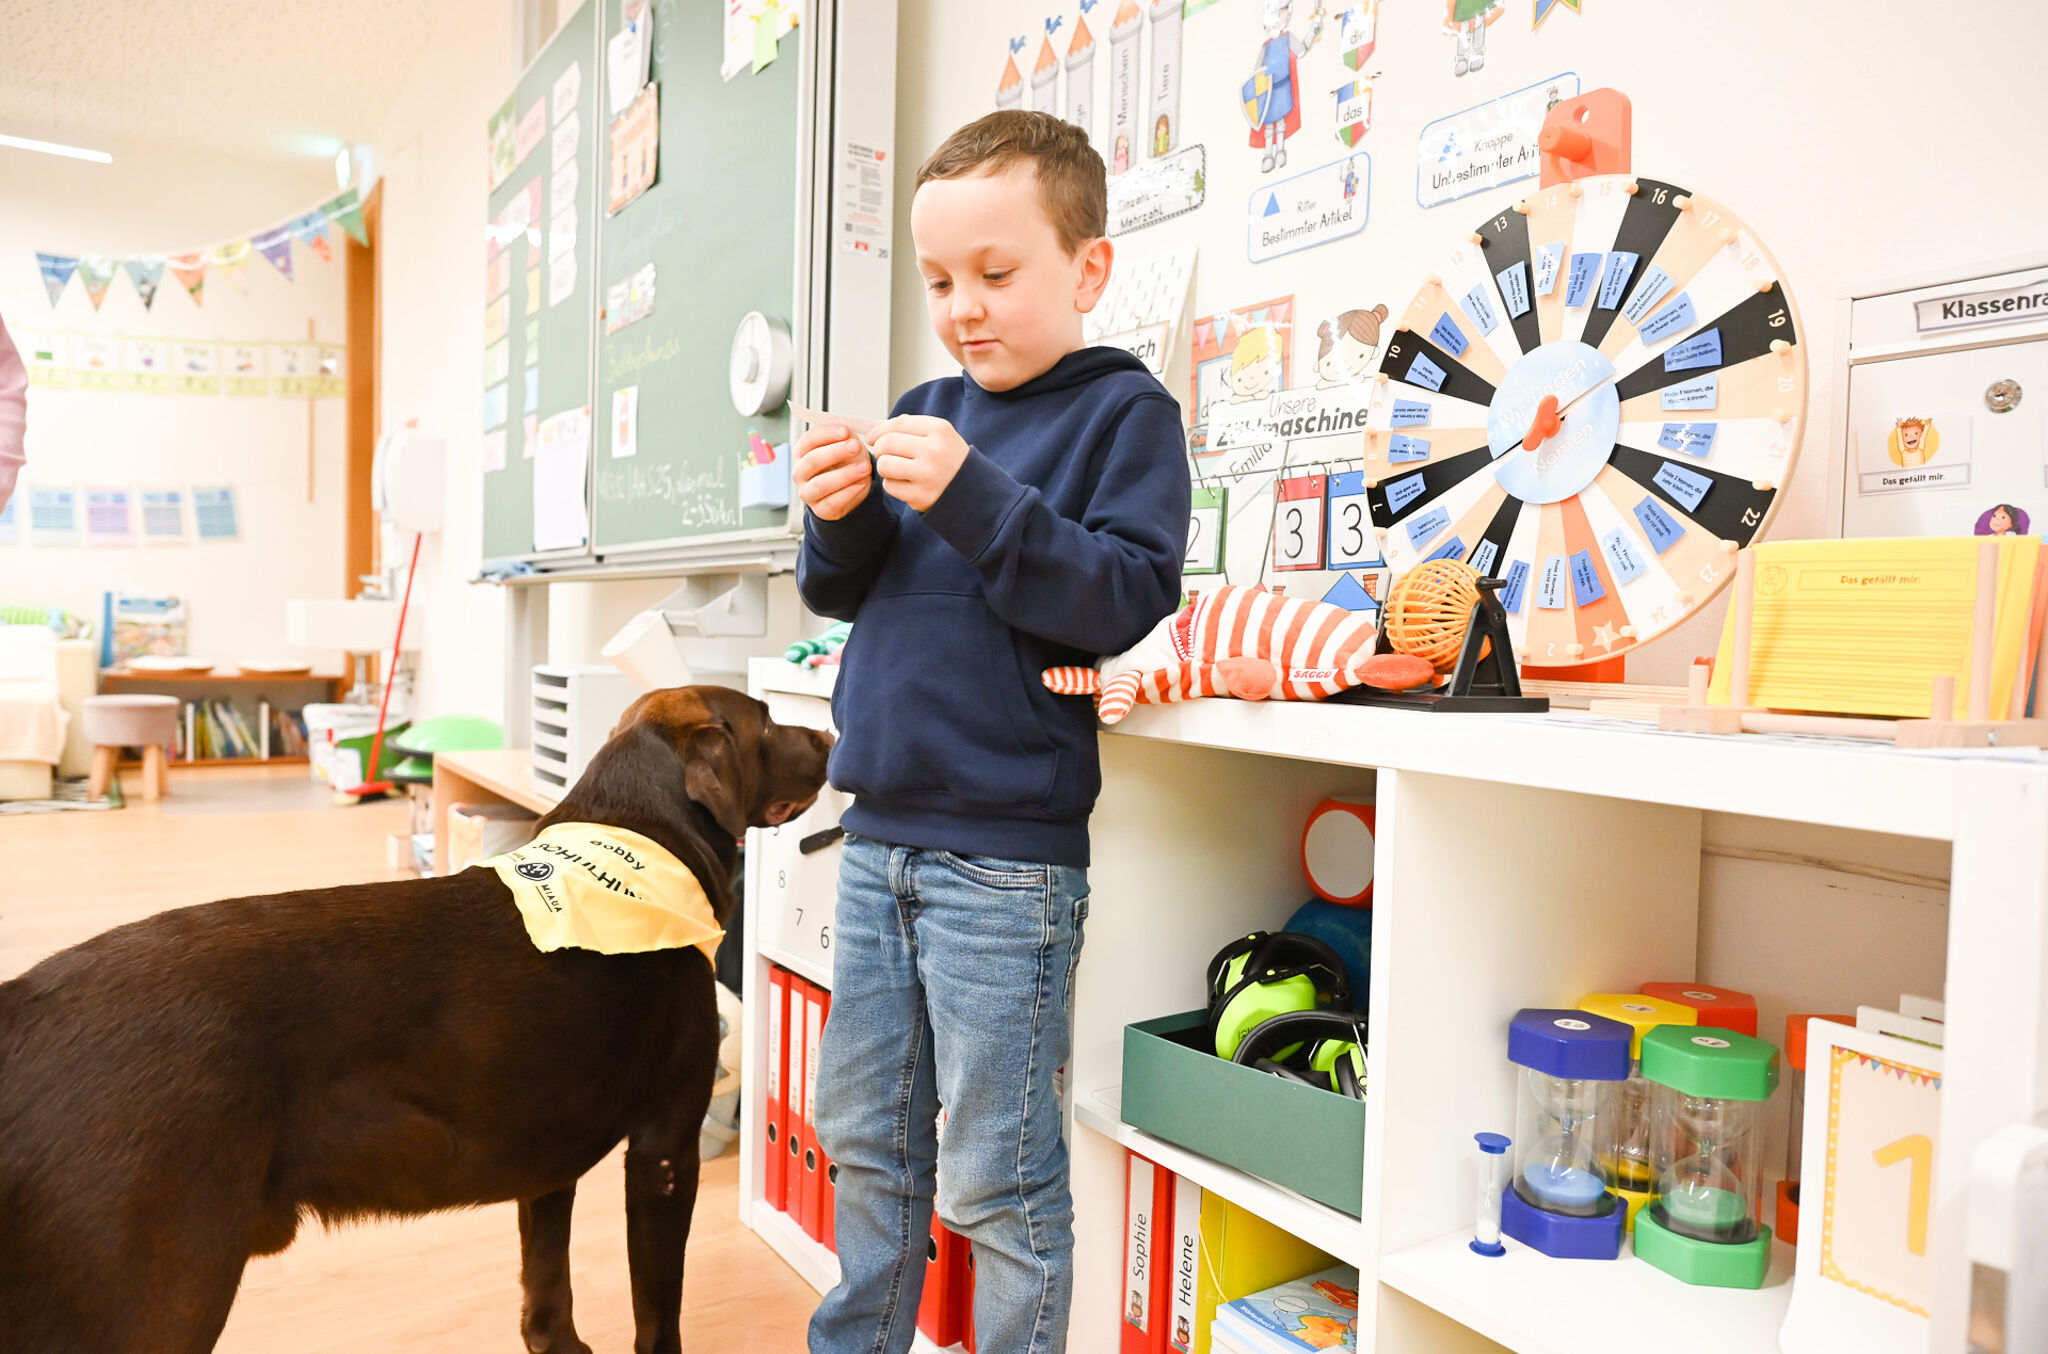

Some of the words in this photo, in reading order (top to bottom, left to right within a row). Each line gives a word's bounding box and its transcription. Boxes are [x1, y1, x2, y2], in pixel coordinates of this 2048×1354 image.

[1117, 48, 1129, 126] Menschen
[1158, 63, 1170, 104] Tiere
[1343, 105, 1363, 121] das
[1651, 187, 1668, 205] 16
[1262, 220, 1318, 247] Bestimmter
[1320, 204, 1353, 229] Artikel
[1494, 216, 1508, 232] 13
[1601, 290, 1609, 305] Finde
[1608, 266, 1617, 286] Nomen
[1767, 309, 1786, 328] 19
[1389, 345, 1402, 359] 10
[1777, 375, 1794, 393] 20
[1269, 395, 1317, 417] Unsere
[1661, 468, 1675, 478] Finde
[1676, 476, 1695, 490] Nomen,
[1882, 477, 1897, 486] Das
[1899, 474, 1927, 486] gefällt
[1372, 503, 1383, 512] 7
[1741, 507, 1760, 527] 22
[1184, 516, 1201, 563] 2
[1285, 508, 1303, 559] 3
[1342, 503, 1363, 557] 3
[1840, 575, 1858, 584] Das
[1861, 574, 1896, 585] gefällt
[778, 869, 786, 888] 8
[796, 907, 804, 926] 7
[820, 926, 830, 949] 6
[1872, 1134, 1933, 1257] 1
[1133, 1212, 1147, 1281] Sophie
[1178, 1234, 1194, 1307] Helene
